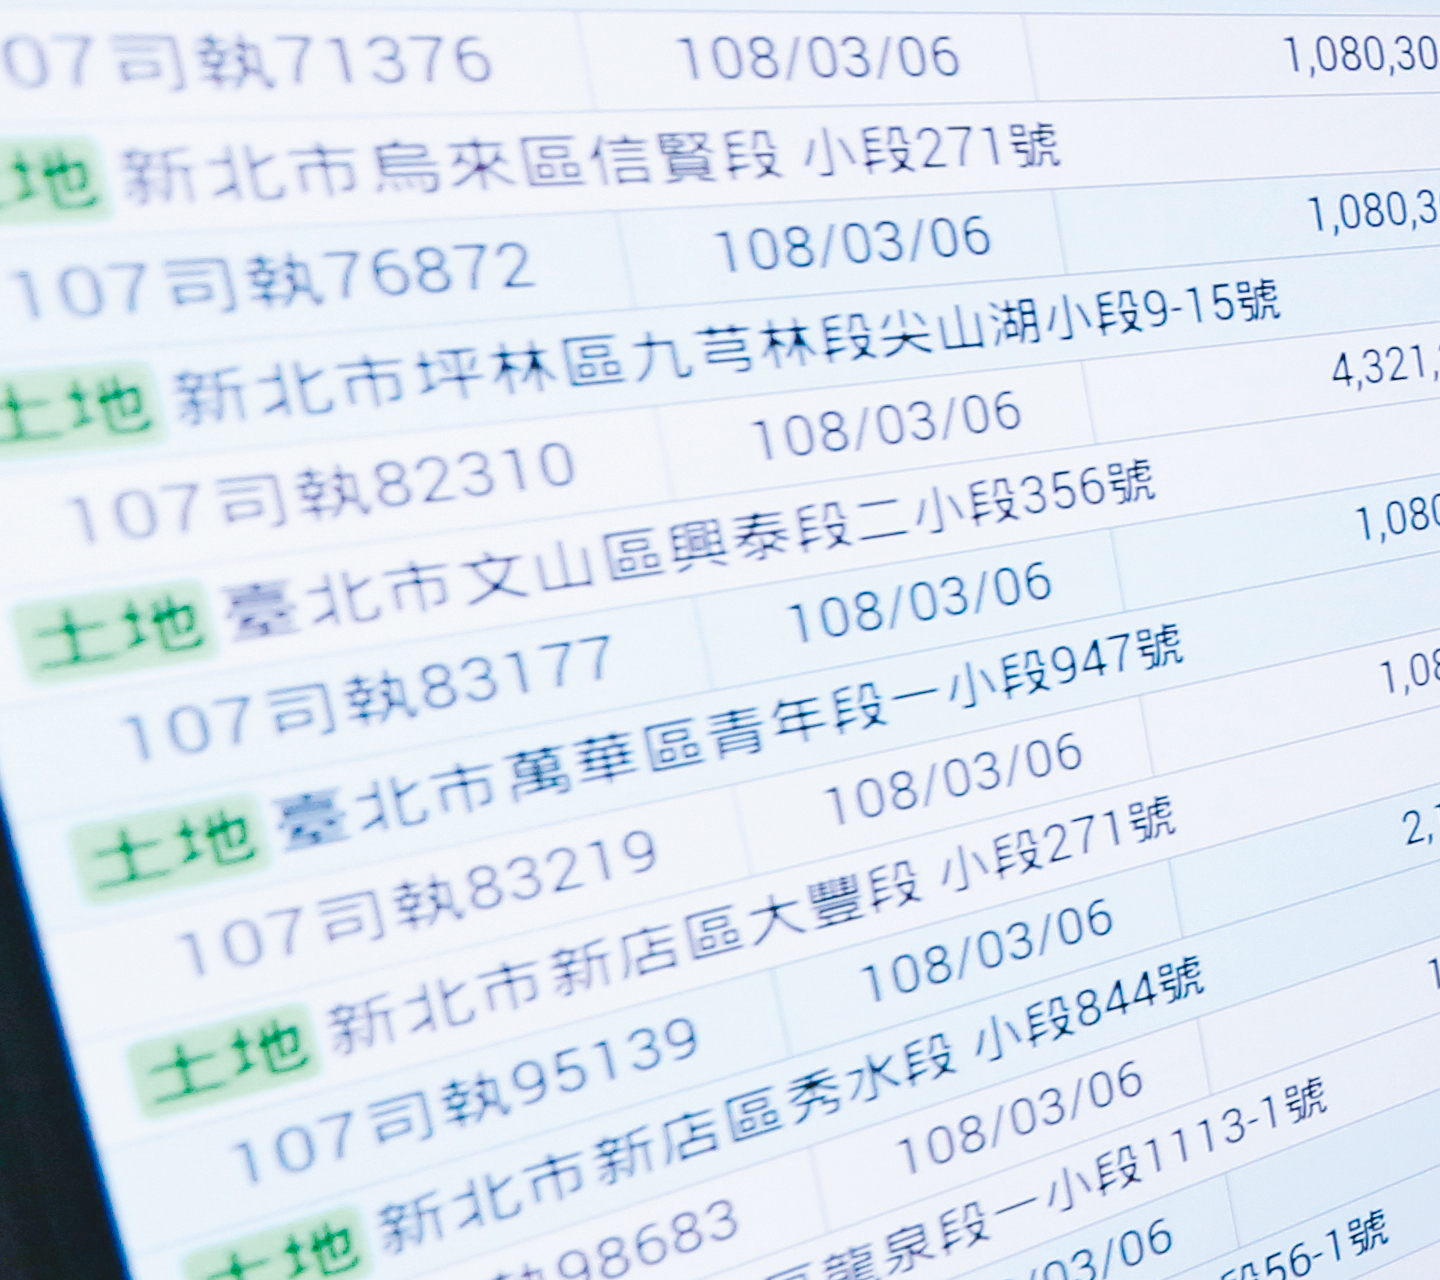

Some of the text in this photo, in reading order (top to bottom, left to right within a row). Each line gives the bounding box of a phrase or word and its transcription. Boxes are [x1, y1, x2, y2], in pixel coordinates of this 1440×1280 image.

[676, 34, 960, 82] 108/03/06
[120, 126, 785, 208] 新北市烏來區信賢段
[804, 121, 1061, 183] 小段271號
[12, 240, 538, 321] 107司執76872
[715, 213, 991, 274] 108/03/06
[0, 373, 152, 446] 土地
[68, 440, 579, 548] 107司執82310
[750, 386, 1020, 462] 108/03/06
[35, 458, 1157, 672] 土地 臺北市文山區興泰段二小段356號
[123, 633, 614, 764] 107司執83177
[785, 564, 1053, 645] 108/03/06
[92, 622, 1185, 889] 土地 臺北市萬華區青年段一小段947號
[179, 827, 659, 979] 107司執83219
[825, 732, 1085, 828] 108/03/06
[146, 794, 1177, 1107] 土地 新北市新店區大豐段 小段271號
[229, 1015, 701, 1189] 107司執95139
[859, 896, 1114, 1006] 108/03/06
[375, 1034, 959, 1258] 新北市新店區秀水段
[971, 952, 1207, 1070] 小段844號
[893, 1057, 1145, 1179] 108/03/06
